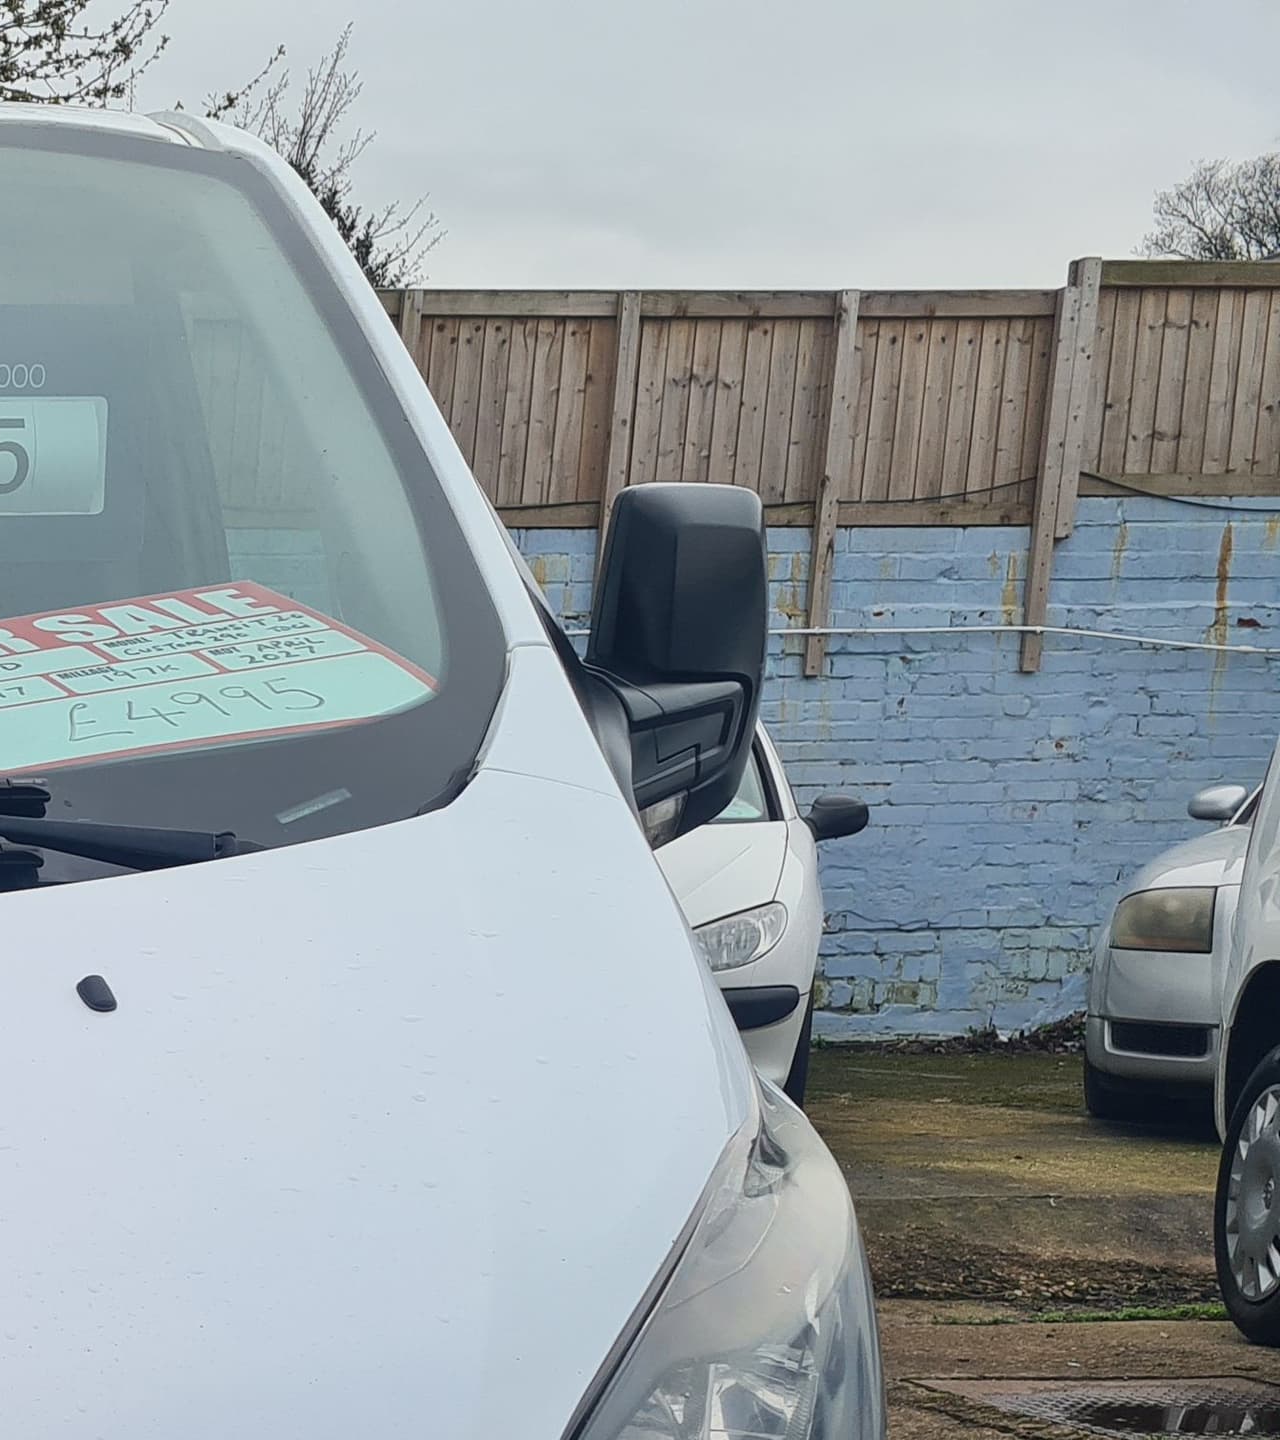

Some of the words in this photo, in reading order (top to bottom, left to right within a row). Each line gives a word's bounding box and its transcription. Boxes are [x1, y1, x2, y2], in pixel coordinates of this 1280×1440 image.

[32, 588, 283, 645] SALE
[207, 645, 239, 657] MOT
[239, 645, 318, 665] 2027
[67, 677, 327, 743] £4995
